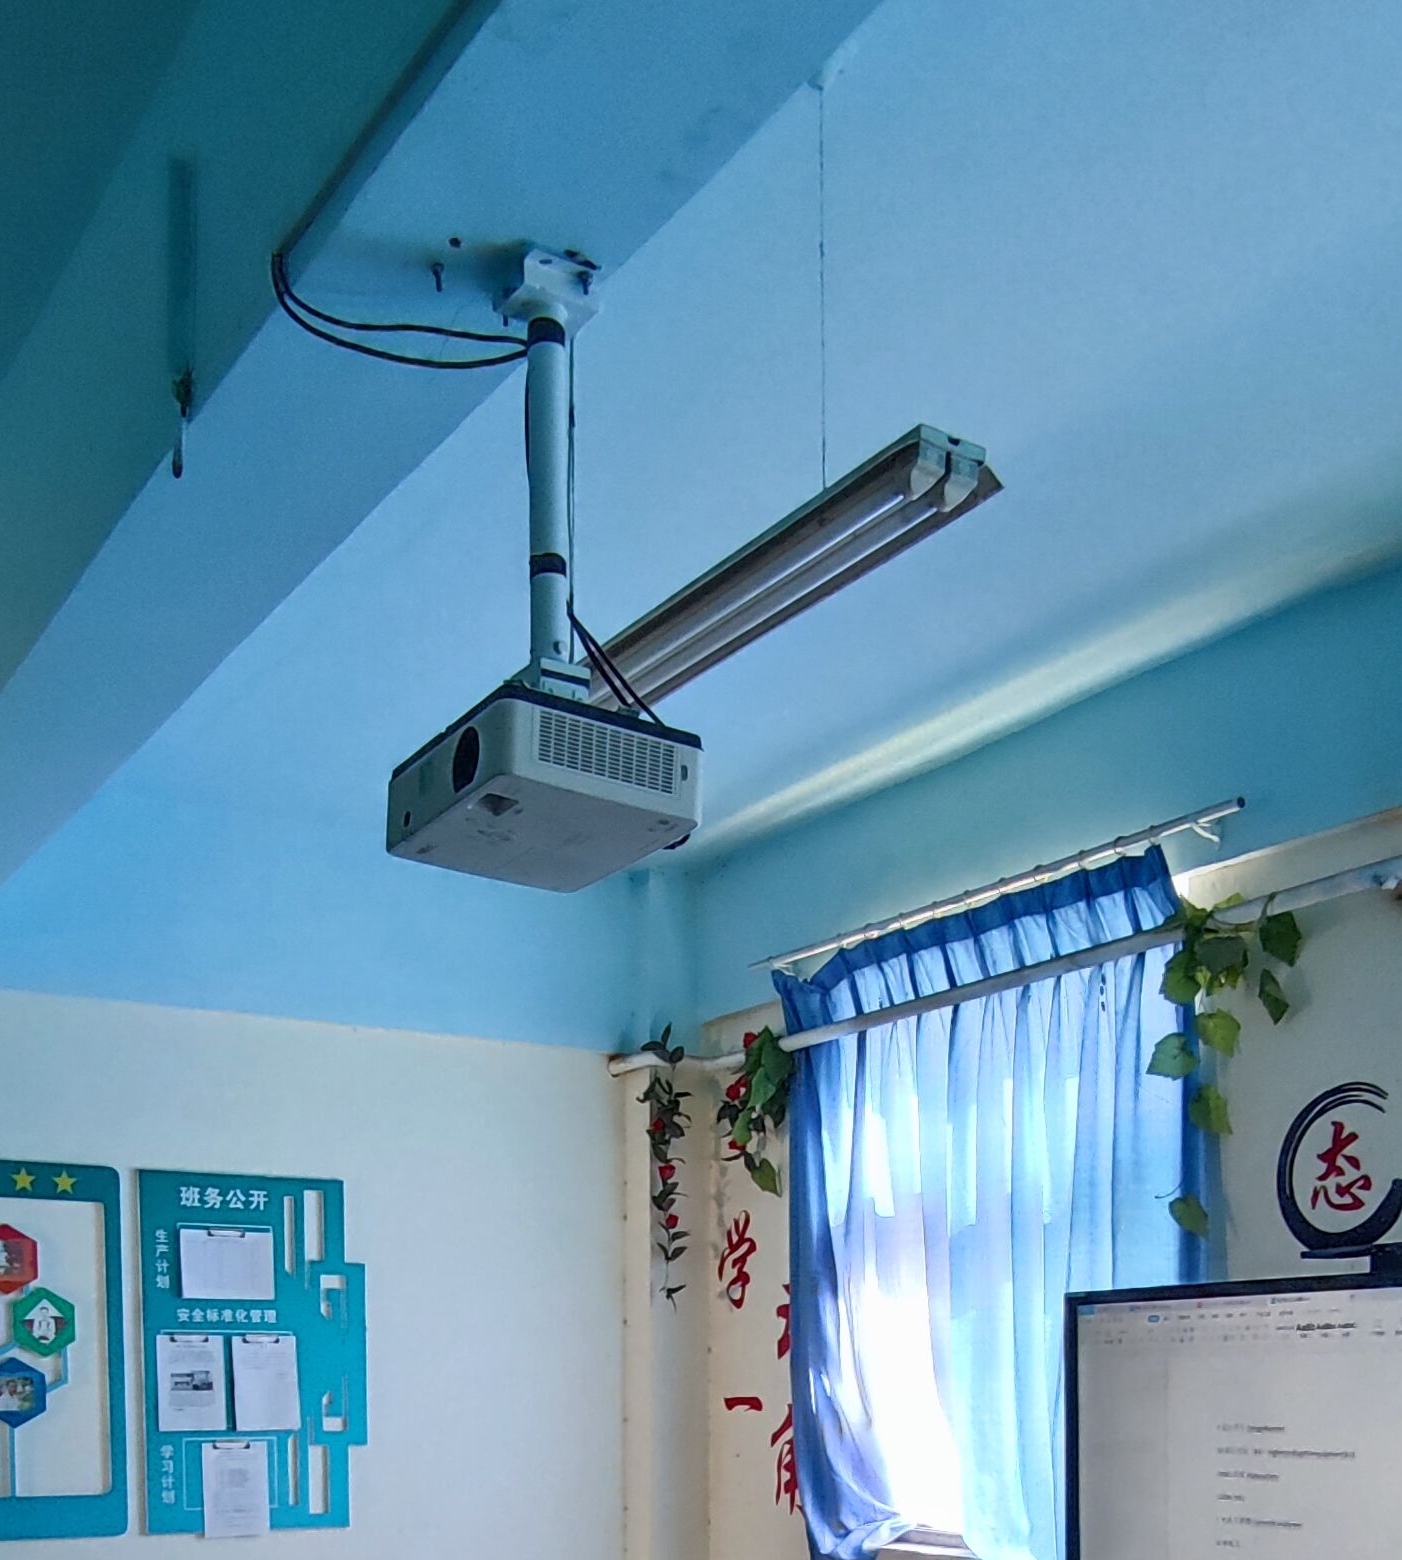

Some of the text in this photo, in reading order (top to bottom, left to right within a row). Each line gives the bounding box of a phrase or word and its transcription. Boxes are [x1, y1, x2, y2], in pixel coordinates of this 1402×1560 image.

[1310, 1121, 1372, 1211] 态
[179, 1186, 269, 1211] 班务公开
[155, 1229, 170, 1289] 生产计划
[176, 1308, 277, 1323] 安全标准化管理
[160, 1444, 176, 1505] 学习计划
